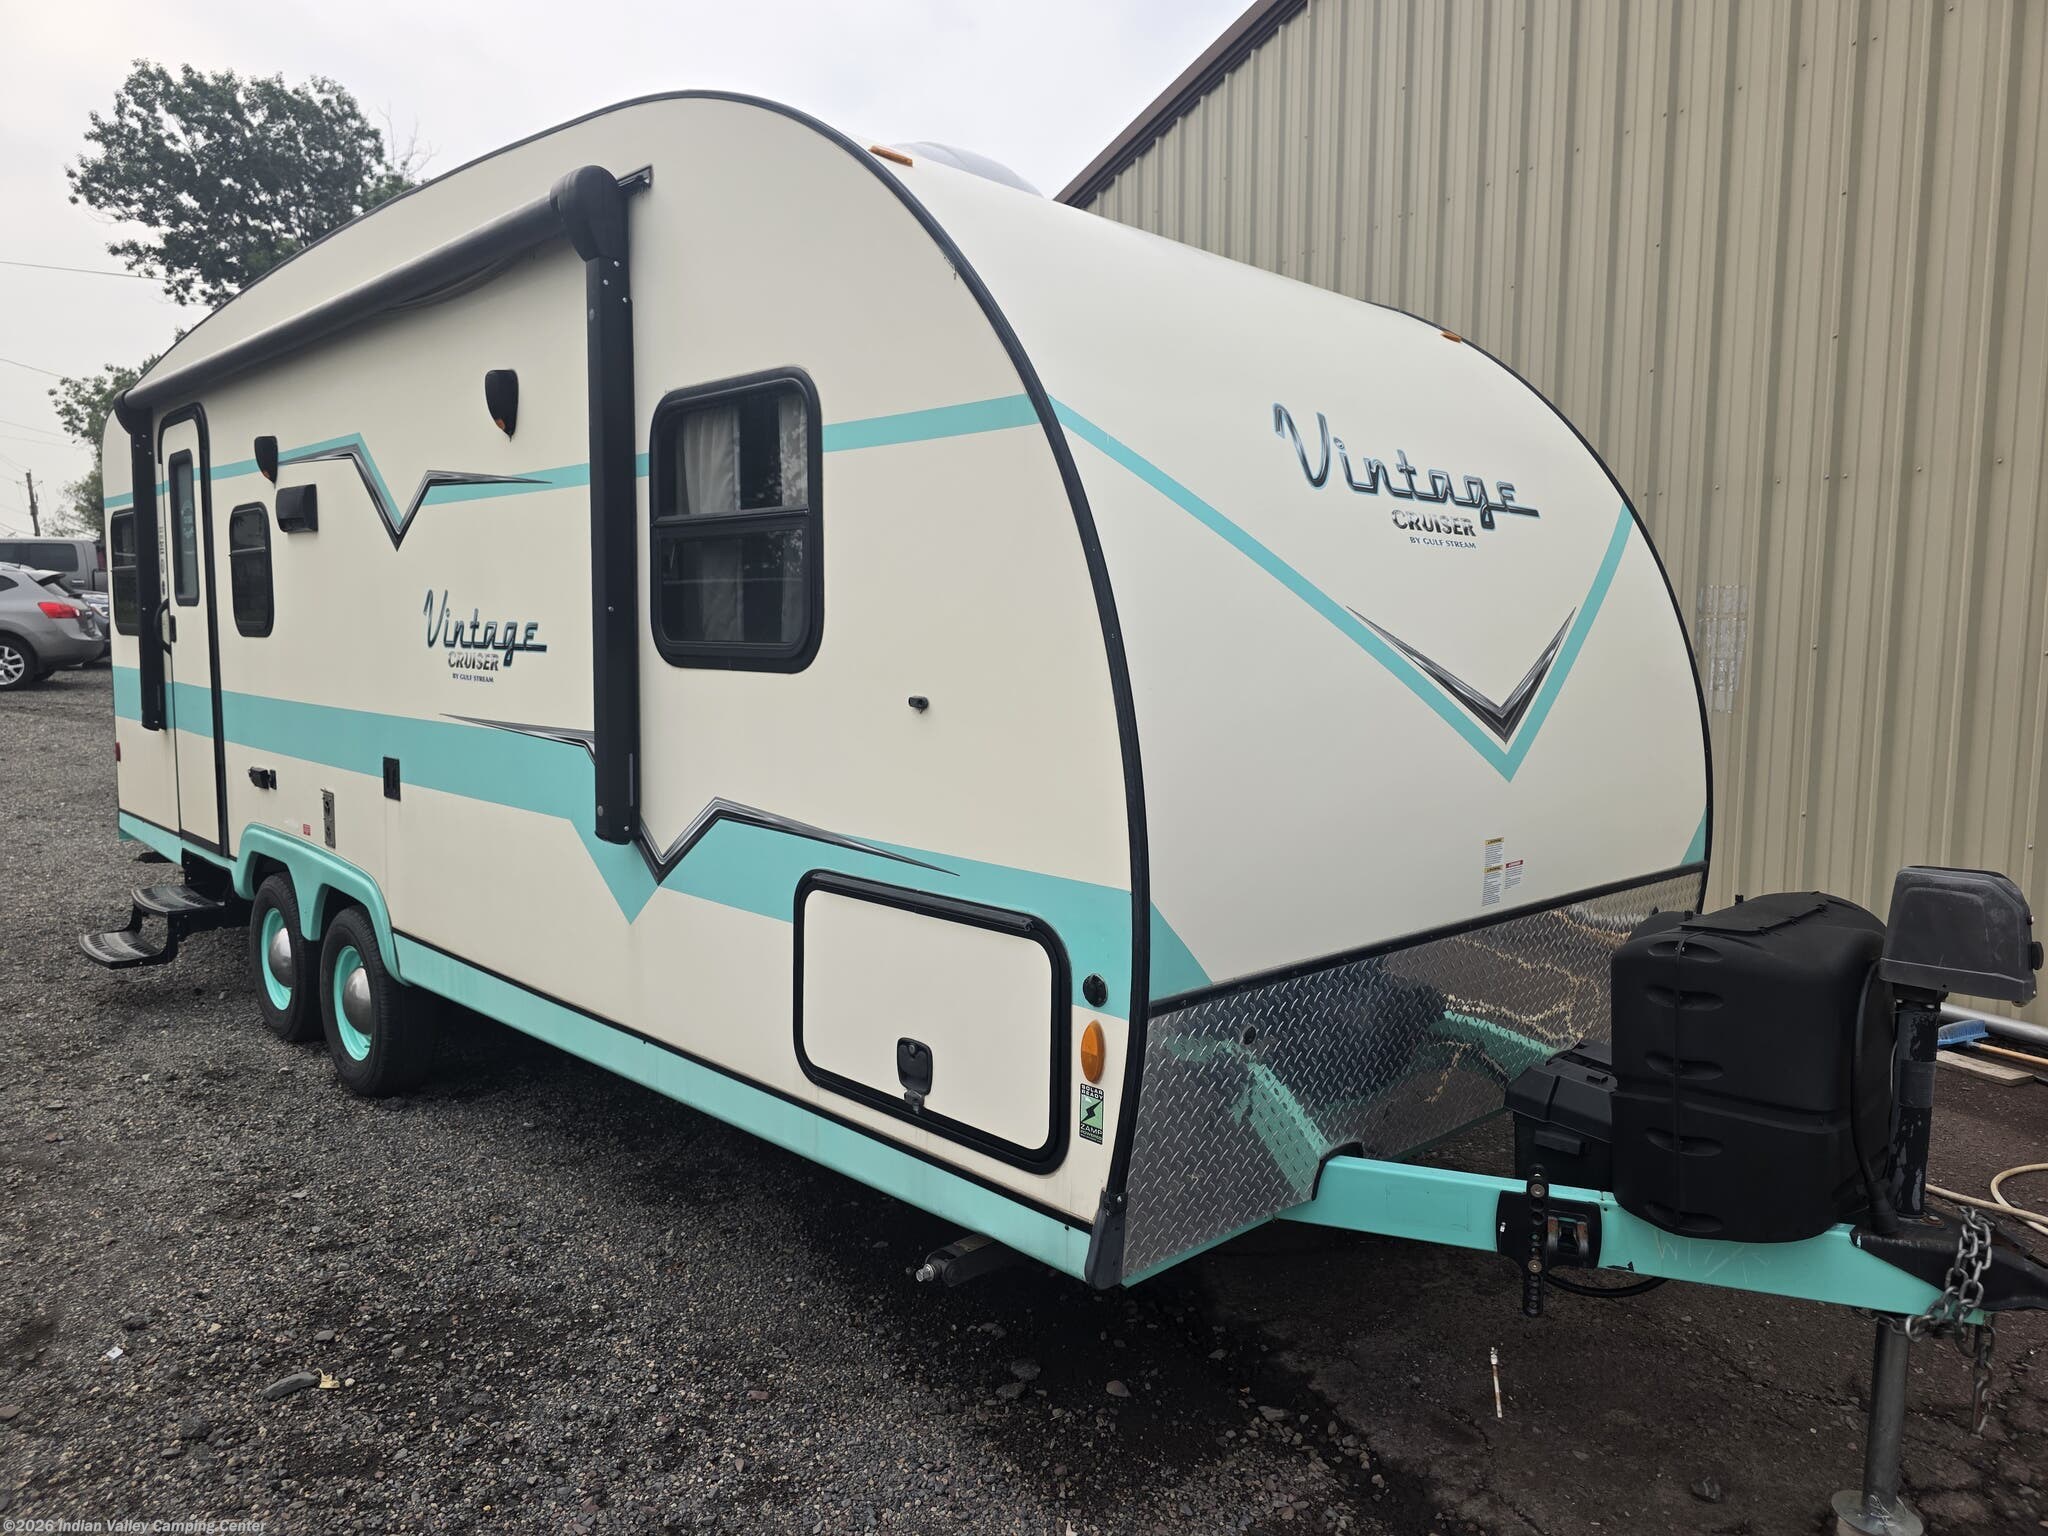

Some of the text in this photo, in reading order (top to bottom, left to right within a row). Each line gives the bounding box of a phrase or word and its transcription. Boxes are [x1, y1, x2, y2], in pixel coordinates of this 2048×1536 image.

[1272, 403, 1540, 530] Vintage
[1391, 509, 1477, 537] CRUISER
[1409, 536, 1477, 550] BY GULF STREAM
[423, 589, 547, 667] Vintage
[448, 650, 499, 671] CRUISER
[452, 672, 494, 683] BY GULF STREAM
[1081, 1085, 1103, 1095] SOLAR
[1081, 1089, 1103, 1100] READY
[1080, 1123, 1103, 1135] ZAMP
